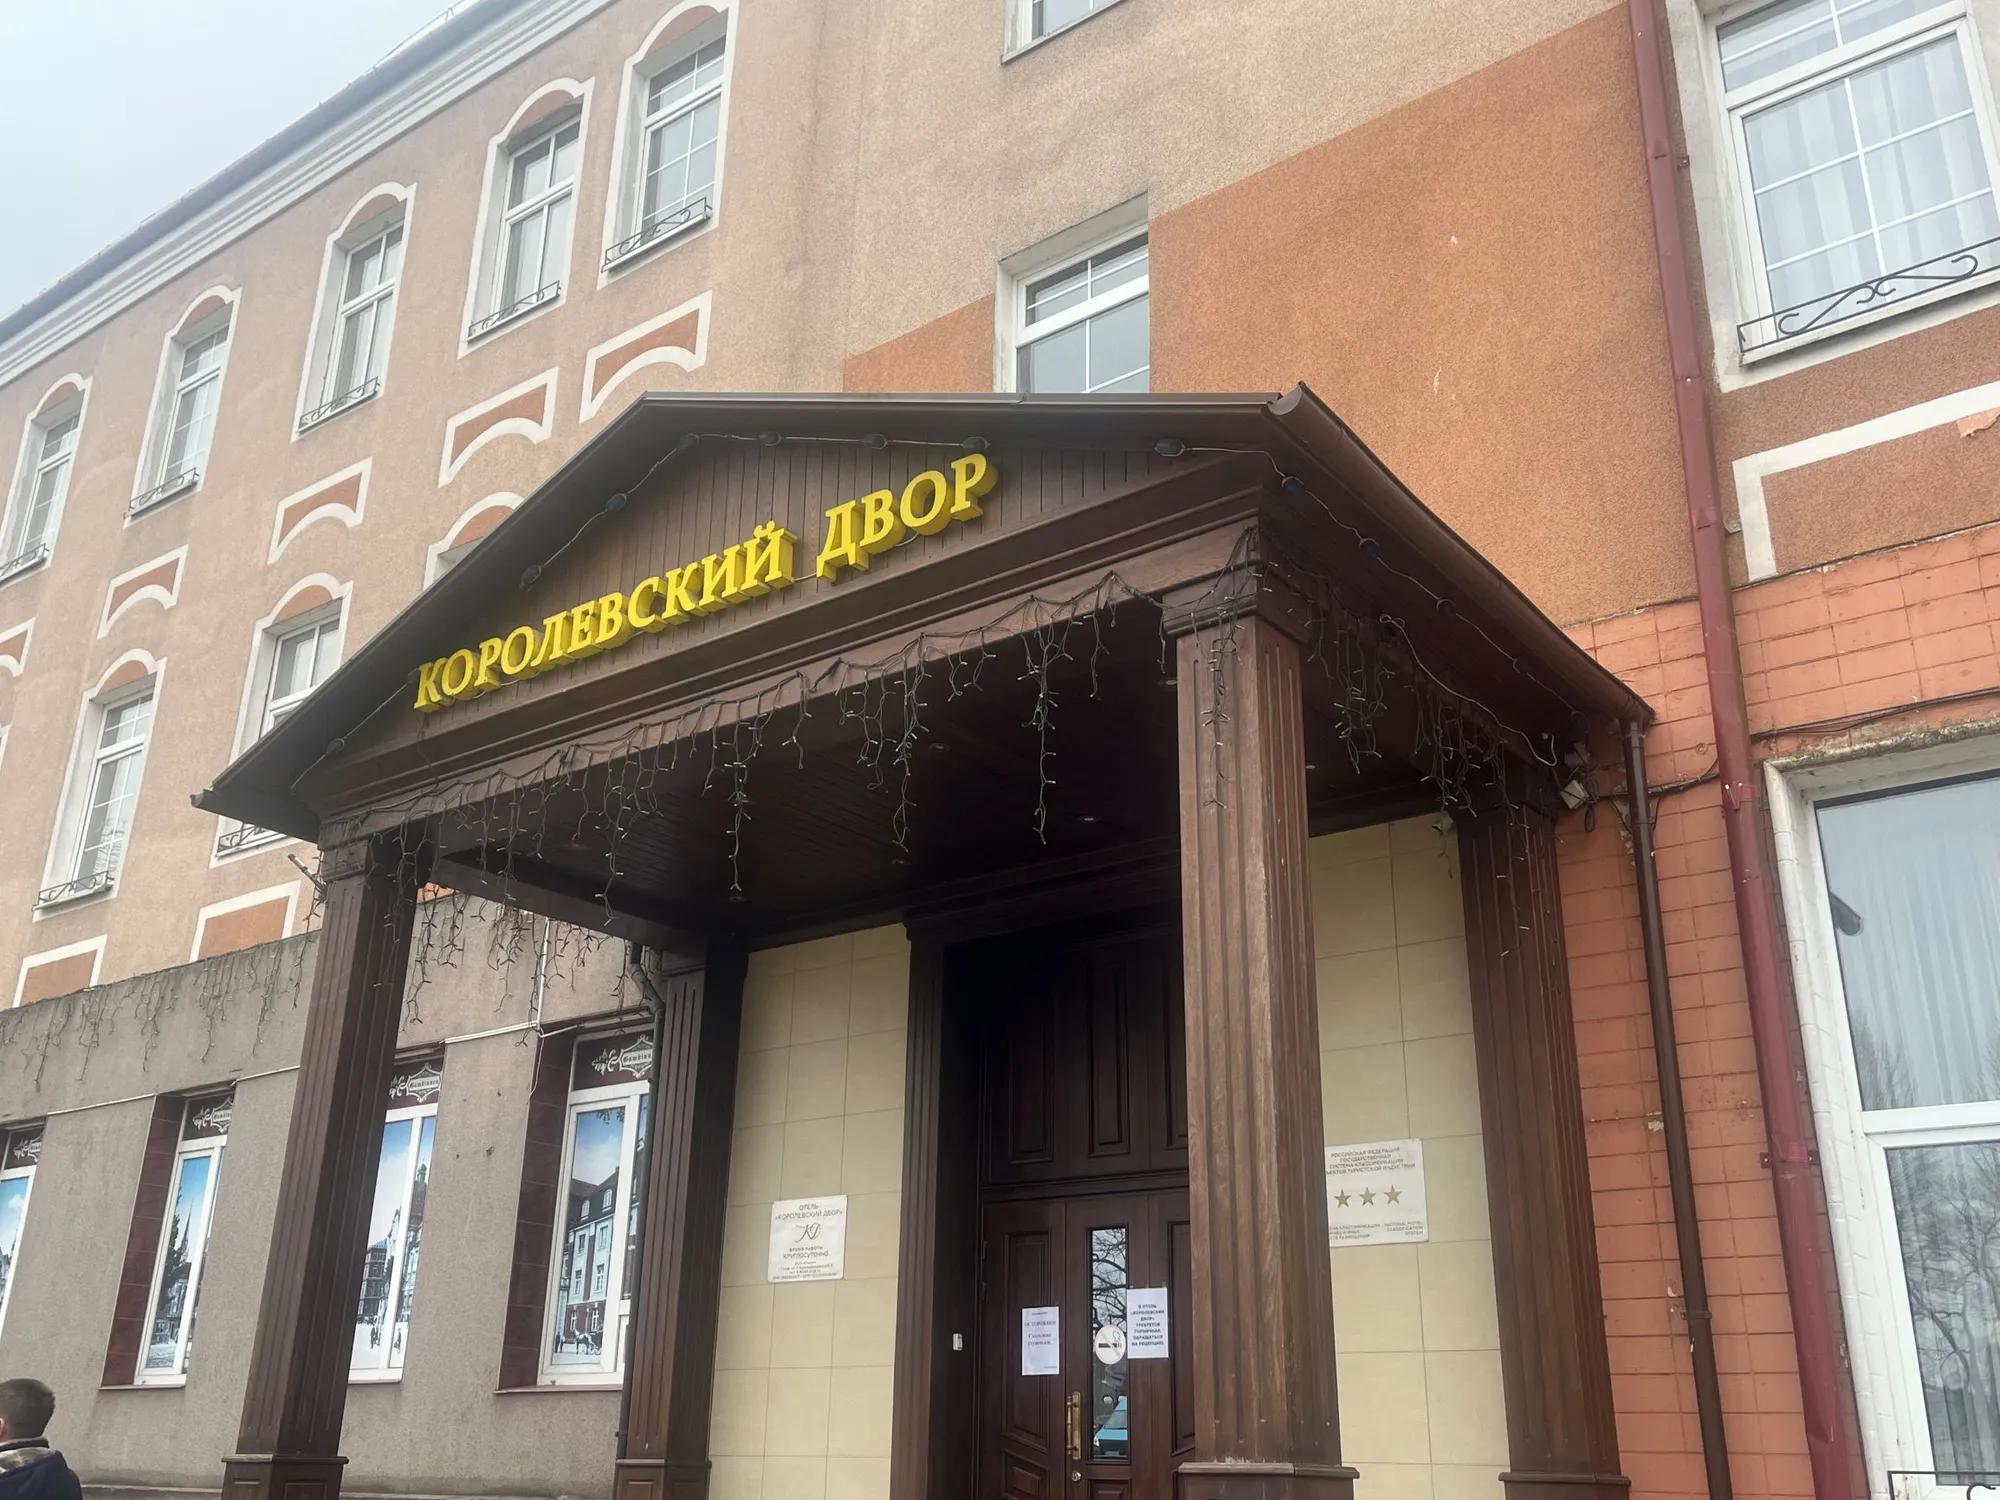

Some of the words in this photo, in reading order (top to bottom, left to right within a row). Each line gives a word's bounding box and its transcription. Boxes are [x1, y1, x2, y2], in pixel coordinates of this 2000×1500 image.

[413, 520, 799, 711] КОРОЛЕВСКИЙ
[816, 453, 996, 582] ДВОР
[1331, 1150, 1367, 1158] РОССИЙСКАЯ
[1367, 1147, 1400, 1155] ФЕДЕРАЦИЯ
